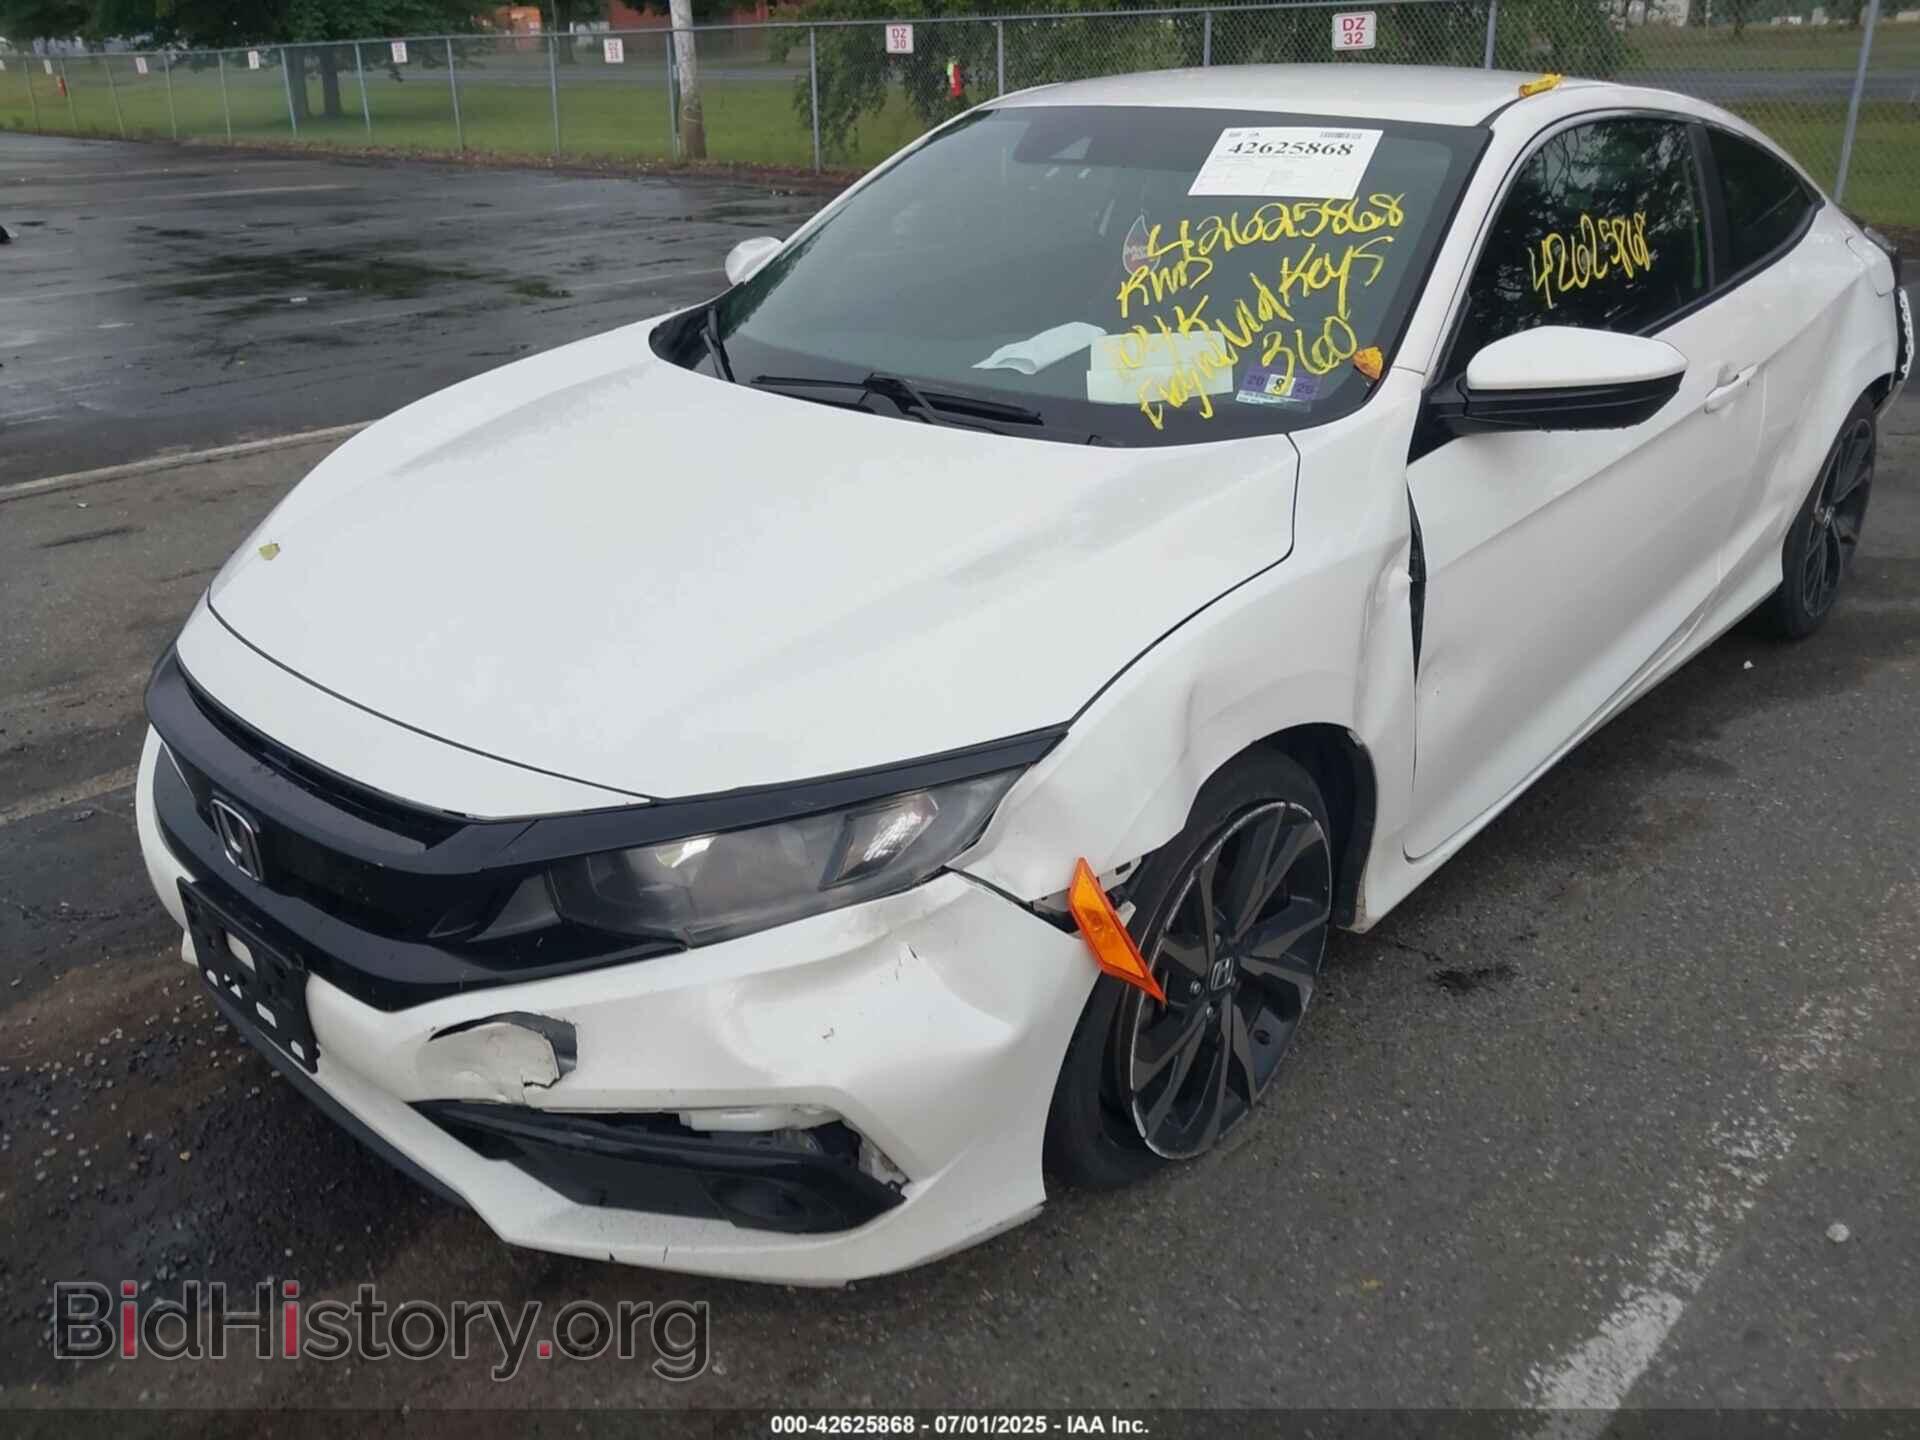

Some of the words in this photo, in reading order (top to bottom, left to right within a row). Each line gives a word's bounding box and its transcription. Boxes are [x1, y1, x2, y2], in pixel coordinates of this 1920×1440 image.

[1343, 17, 1366, 31] DZ
[892, 27, 907, 39] DZ
[1343, 31, 1364, 45] 32
[1227, 141, 1354, 157] 42625868
[1147, 193, 1405, 257] 42625868
[1527, 211, 1650, 309] 42625868
[1261, 314, 1358, 395] 360
